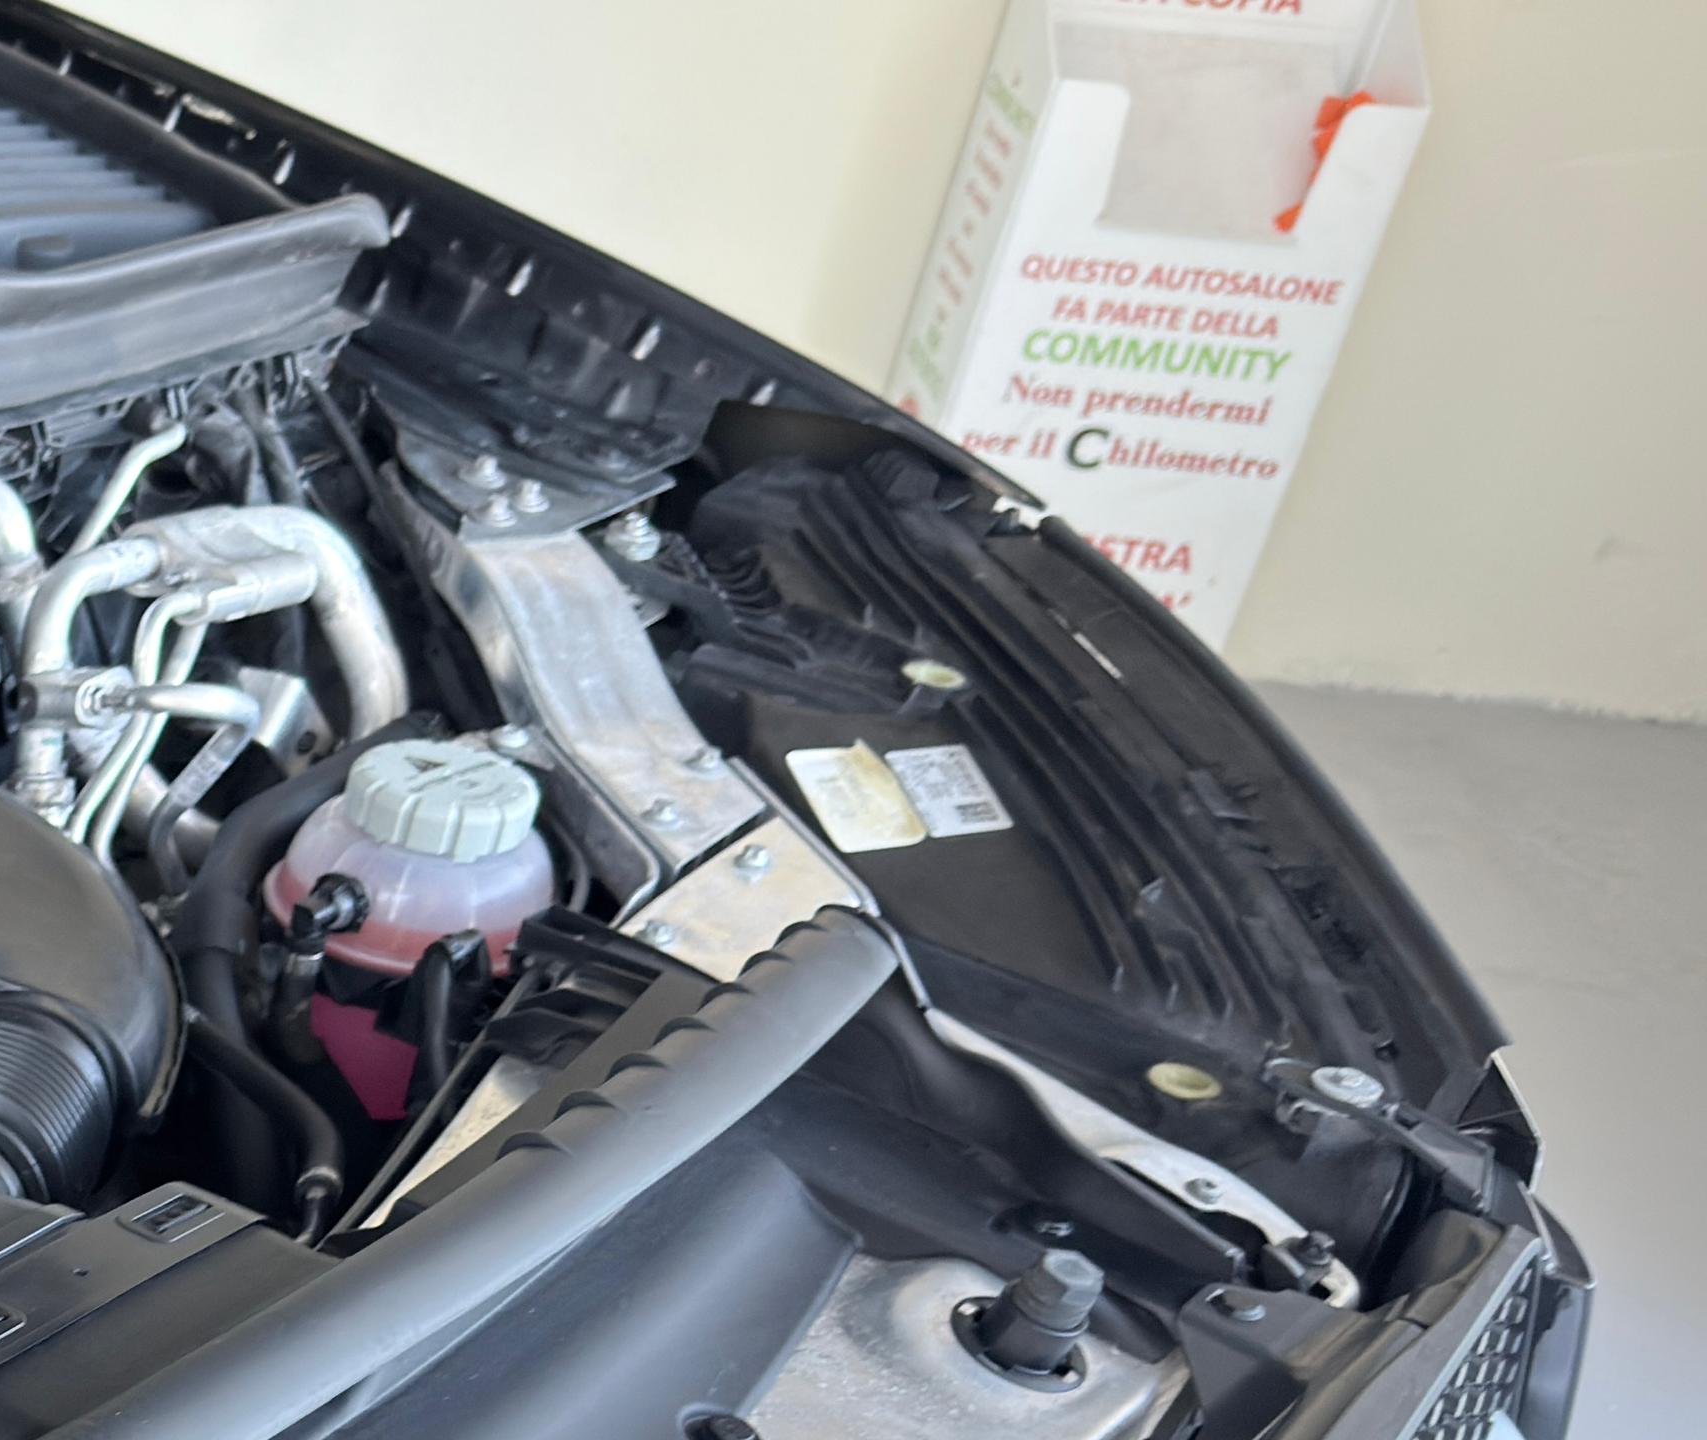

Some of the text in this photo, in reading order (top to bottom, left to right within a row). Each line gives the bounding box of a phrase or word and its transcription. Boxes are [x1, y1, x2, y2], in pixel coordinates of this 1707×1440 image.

[1021, 254, 1345, 305] QUESTO AUTOSALONE
[1053, 296, 1280, 338] FA PARTE DELLA
[1022, 329, 1291, 381] COMMUNITY
[1004, 373, 1273, 426] Non prendermi
[1027, 431, 1057, 458] il
[1065, 427, 1279, 480] Chilometro
[1083, 533, 1194, 574] STRA
